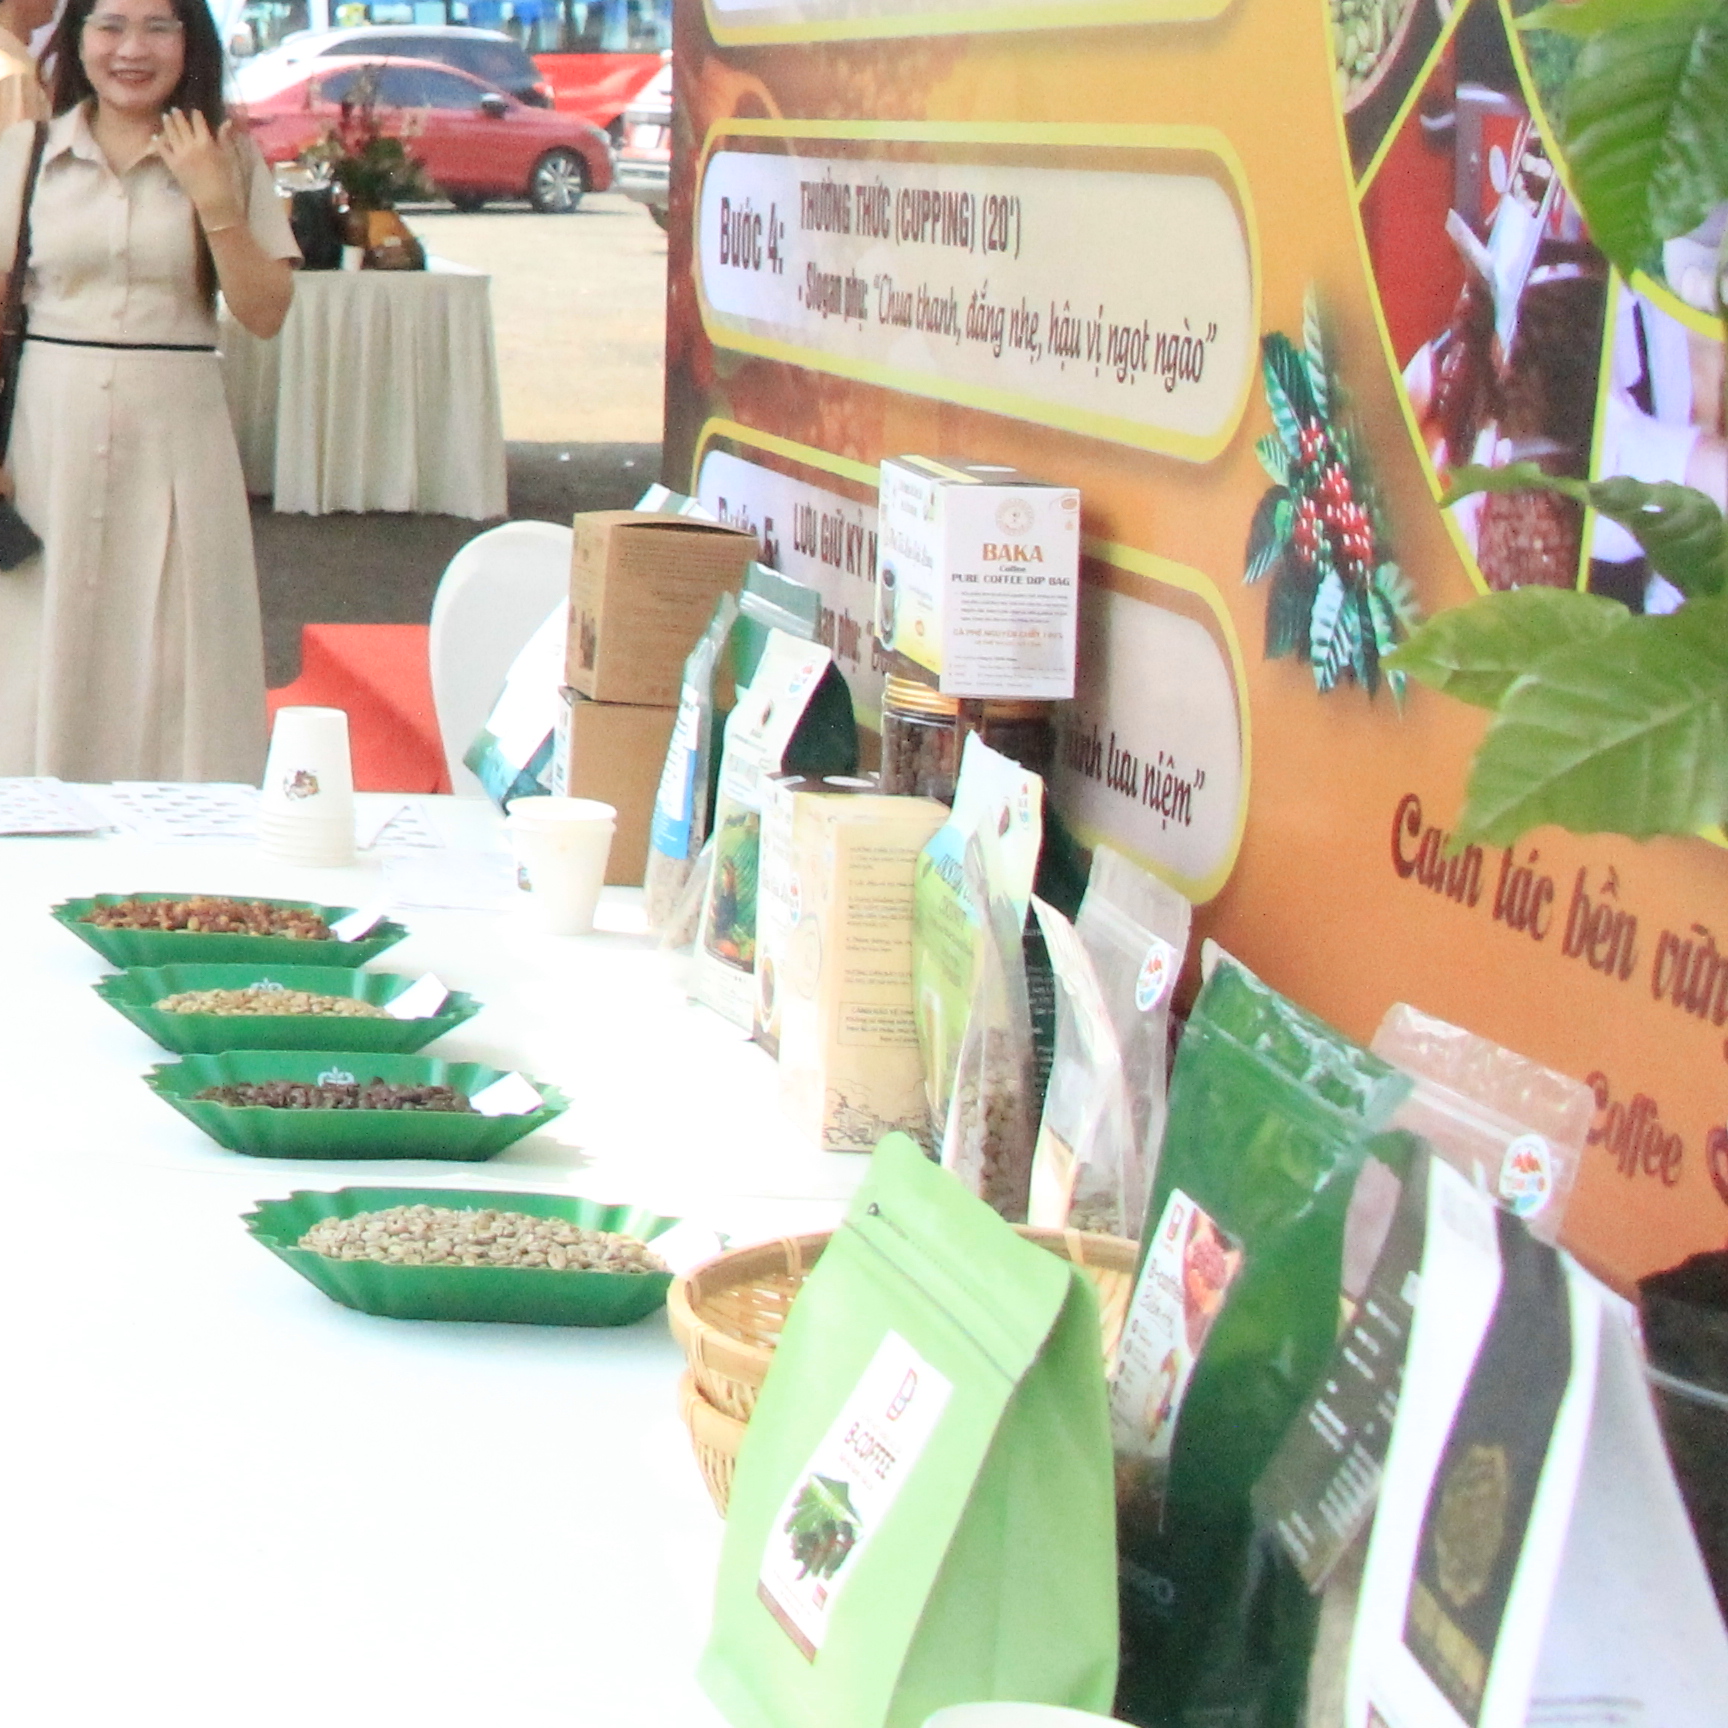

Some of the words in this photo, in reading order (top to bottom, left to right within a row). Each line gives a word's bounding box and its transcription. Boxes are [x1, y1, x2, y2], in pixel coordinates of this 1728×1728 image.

[720, 195, 762, 272] Bước
[767, 202, 784, 275] 4:
[799, 165, 851, 235] THƯỞNG
[855, 174, 891, 240] THỨC
[895, 186, 975, 253] (CUPPING)
[982, 194, 1022, 260] (20')
[805, 261, 842, 320] Slogan
[916, 281, 962, 347] thanh,
[966, 279, 1004, 358] đắng
[1008, 296, 1042, 364] nhẹ,
[1047, 300, 1082, 372] hậu
[1086, 303, 1103, 378] vị
[1106, 319, 1149, 387] ngọt
[794, 502, 817, 558] LƯU
[821, 508, 844, 569] GIỮ
[846, 508, 864, 577] KỶ
[951, 573, 979, 584] PURE
[983, 574, 1023, 585] COFFEE
[1048, 576, 1070, 587] BAG
[982, 543, 1044, 563] BAKA
[1107, 732, 1138, 798] lưu
[1143, 750, 1205, 830] niệm”
[1492, 846, 1554, 941] tác
[1561, 866, 1638, 982] bền
[1587, 1071, 1683, 1187] Coffee
